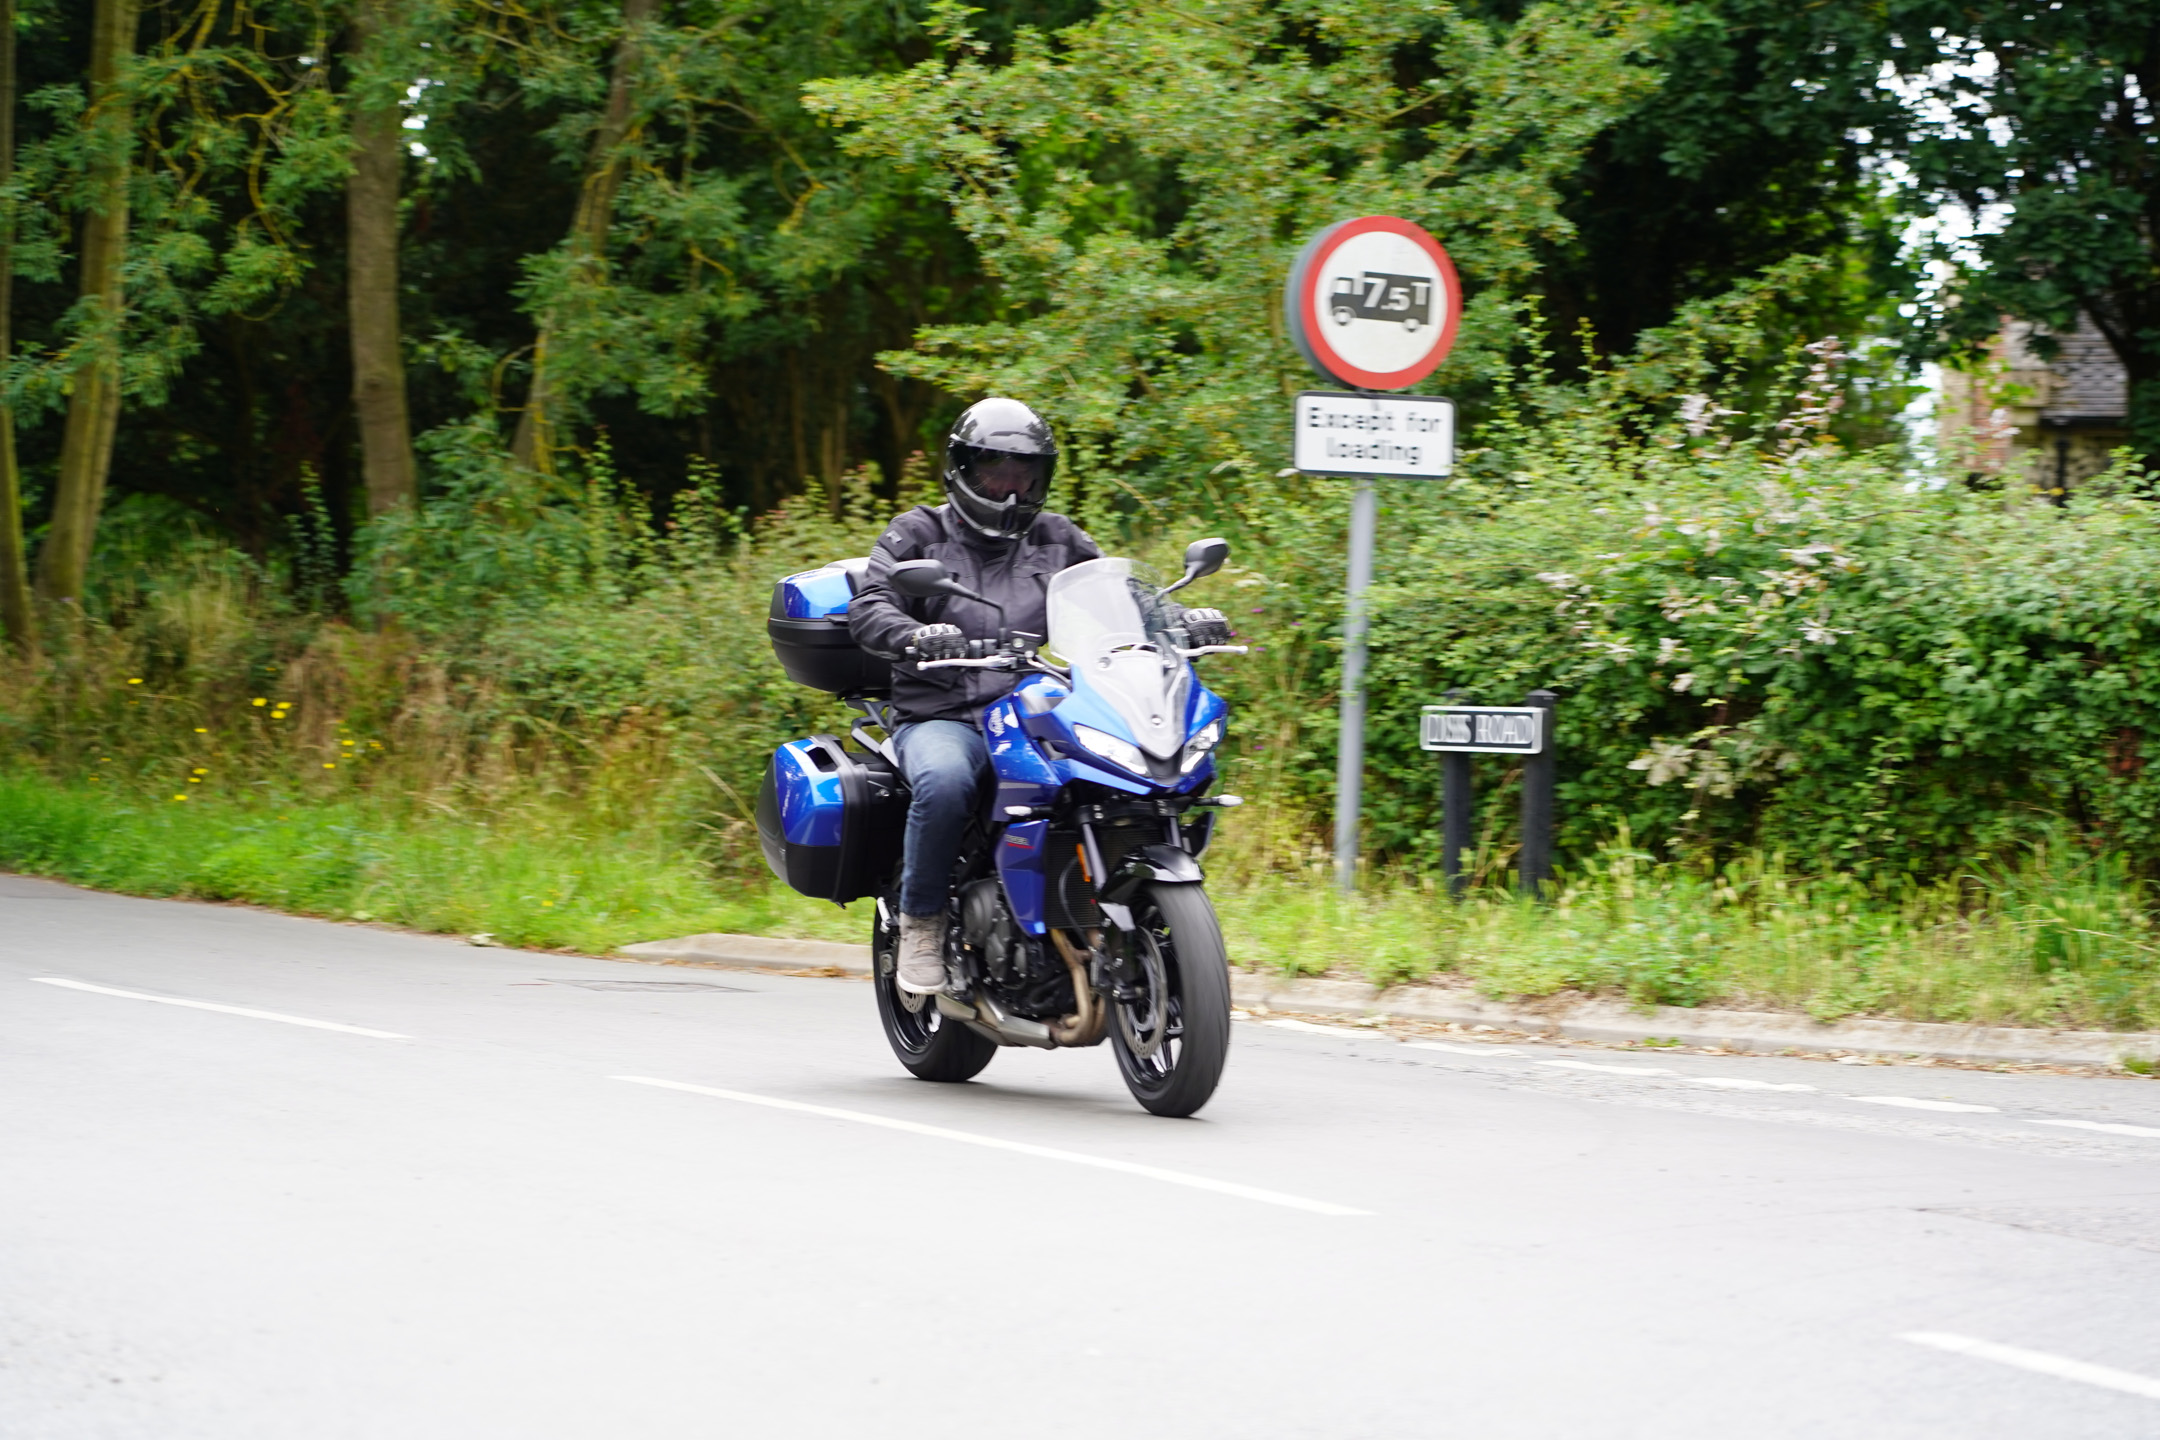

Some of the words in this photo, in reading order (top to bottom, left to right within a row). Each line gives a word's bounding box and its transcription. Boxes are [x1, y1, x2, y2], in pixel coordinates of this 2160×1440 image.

[1308, 406, 1393, 434] Except
[1406, 411, 1441, 433] for
[1327, 438, 1420, 465] loading
[1475, 715, 1535, 744] ROAD
